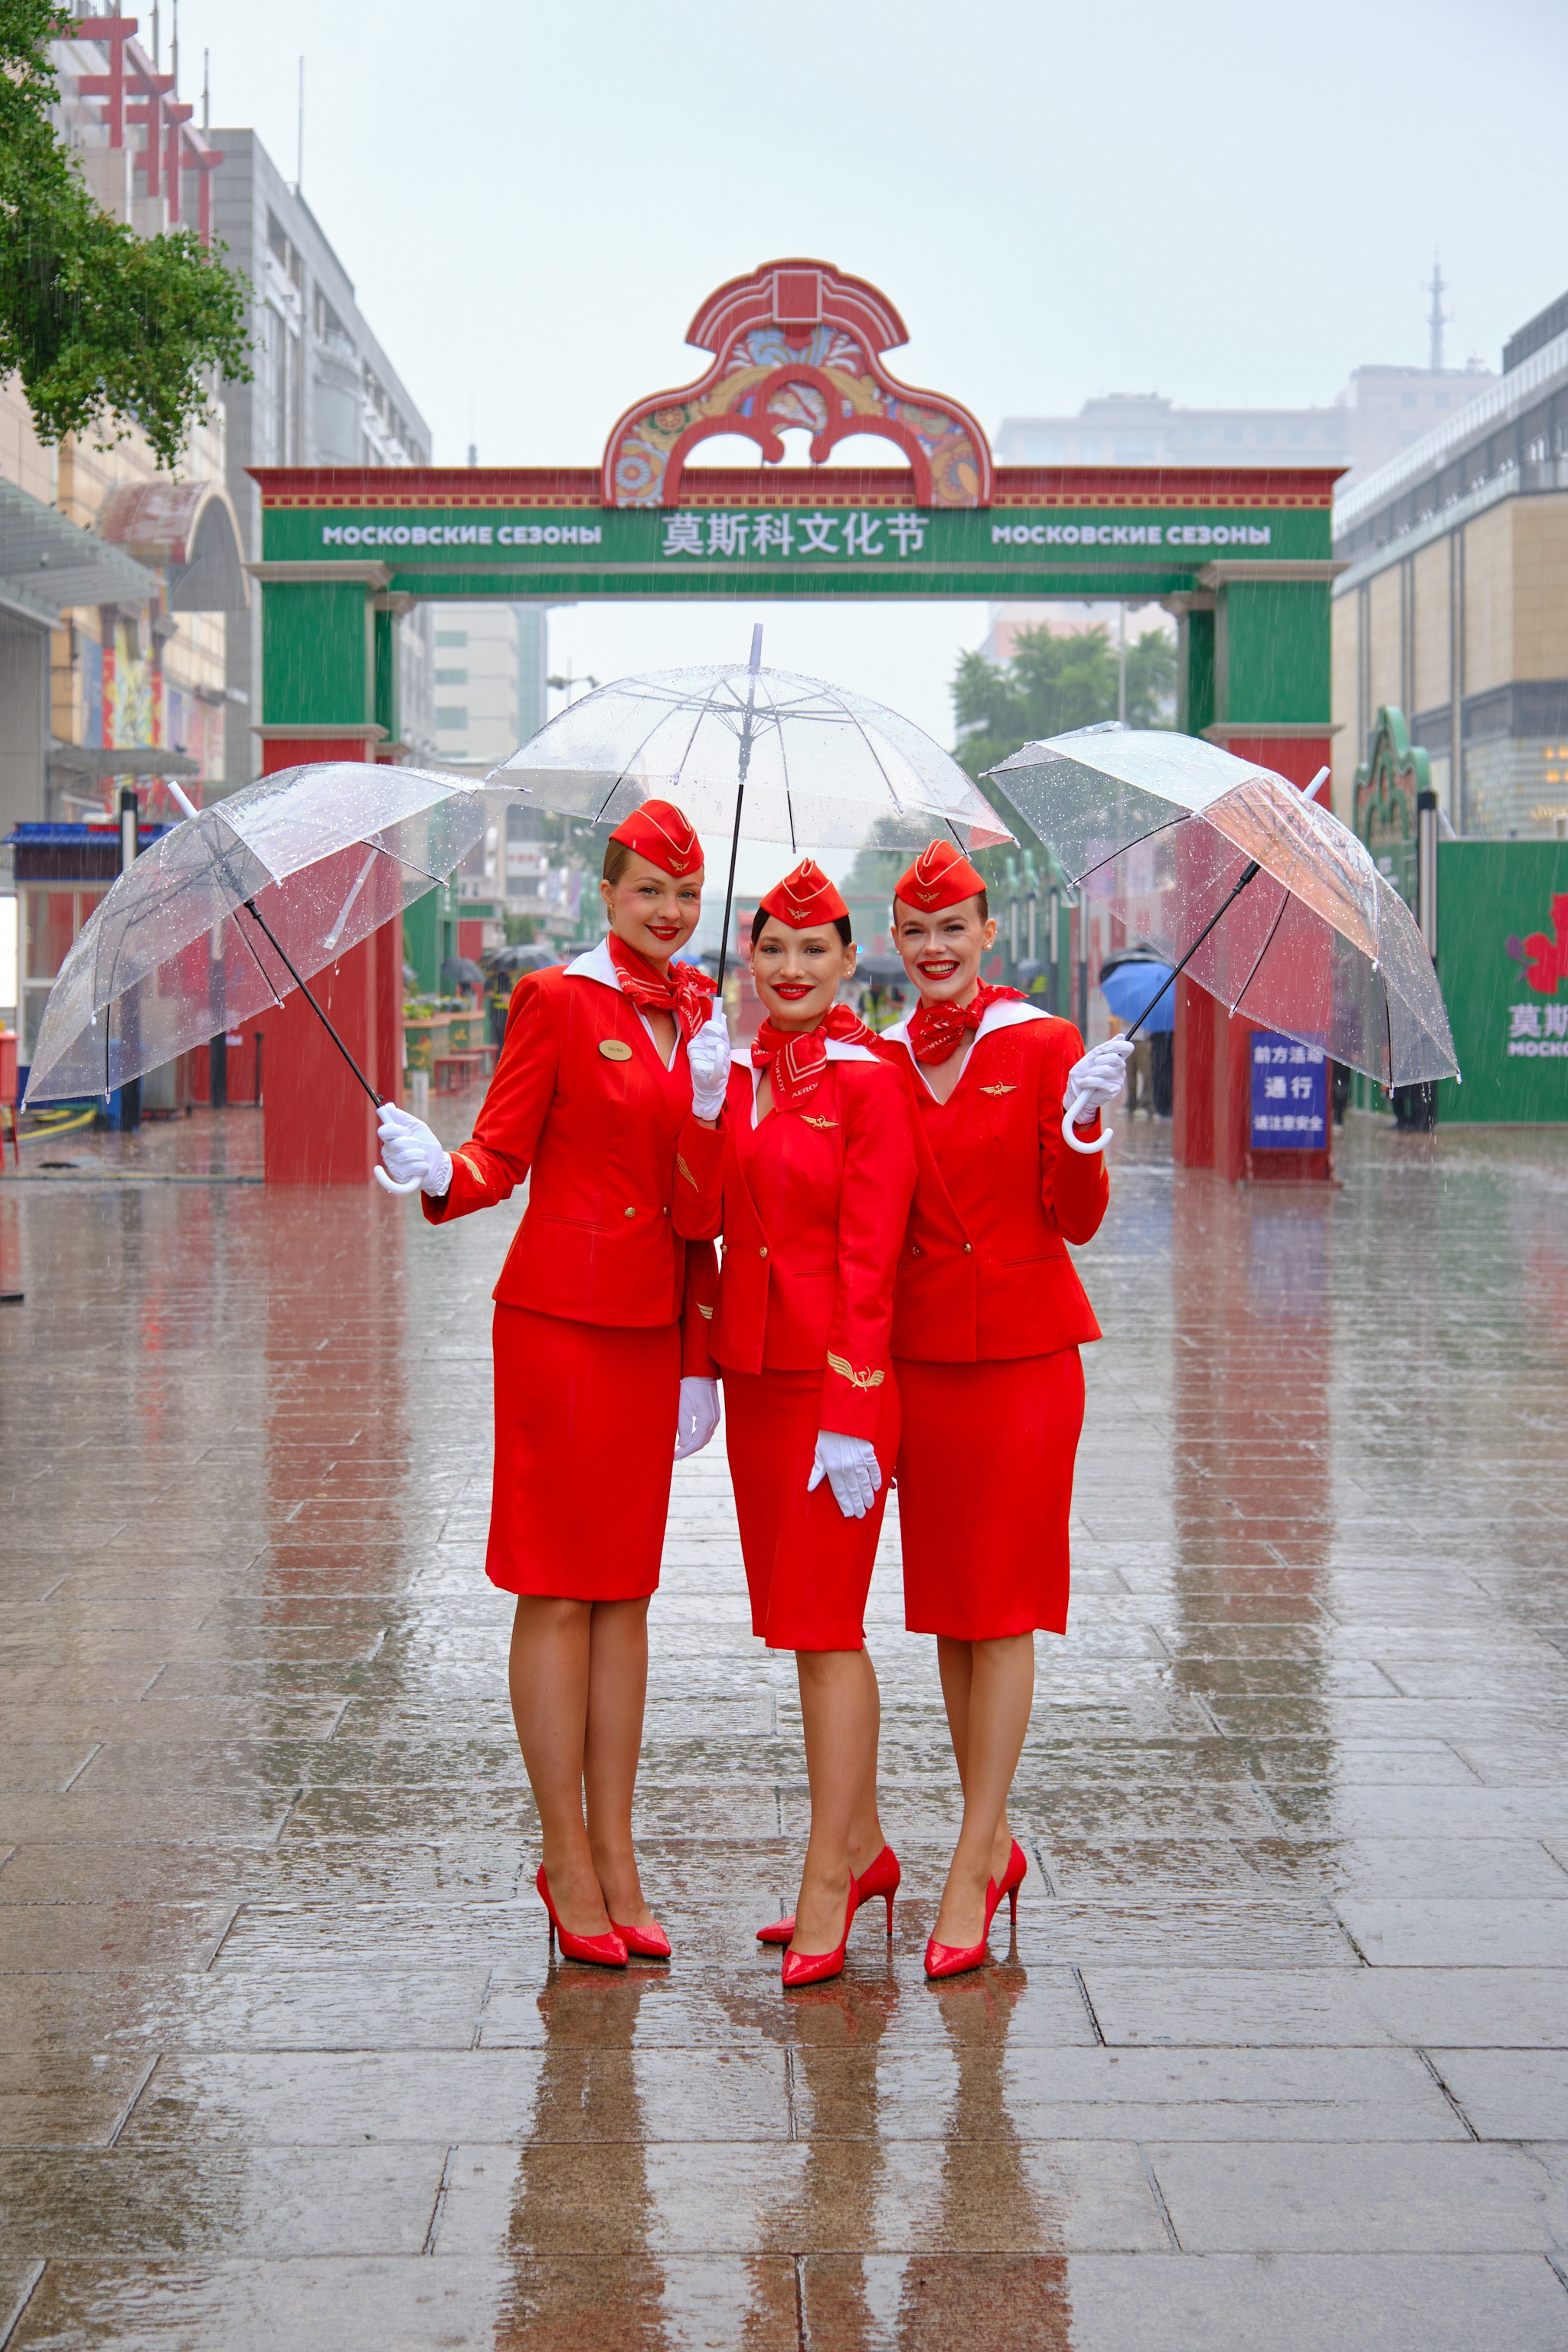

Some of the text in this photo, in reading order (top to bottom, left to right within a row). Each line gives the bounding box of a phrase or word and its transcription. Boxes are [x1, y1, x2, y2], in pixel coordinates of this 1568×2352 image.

[322, 526, 602, 545] МОСКОВСКИЕ СЕЗОНЫ
[662, 512, 929, 557] 莫斯科文化节
[991, 526, 1271, 545] МОСКОВСКИЕ СЕЗОНЫ
[1264, 1076, 1313, 1099] 通行
